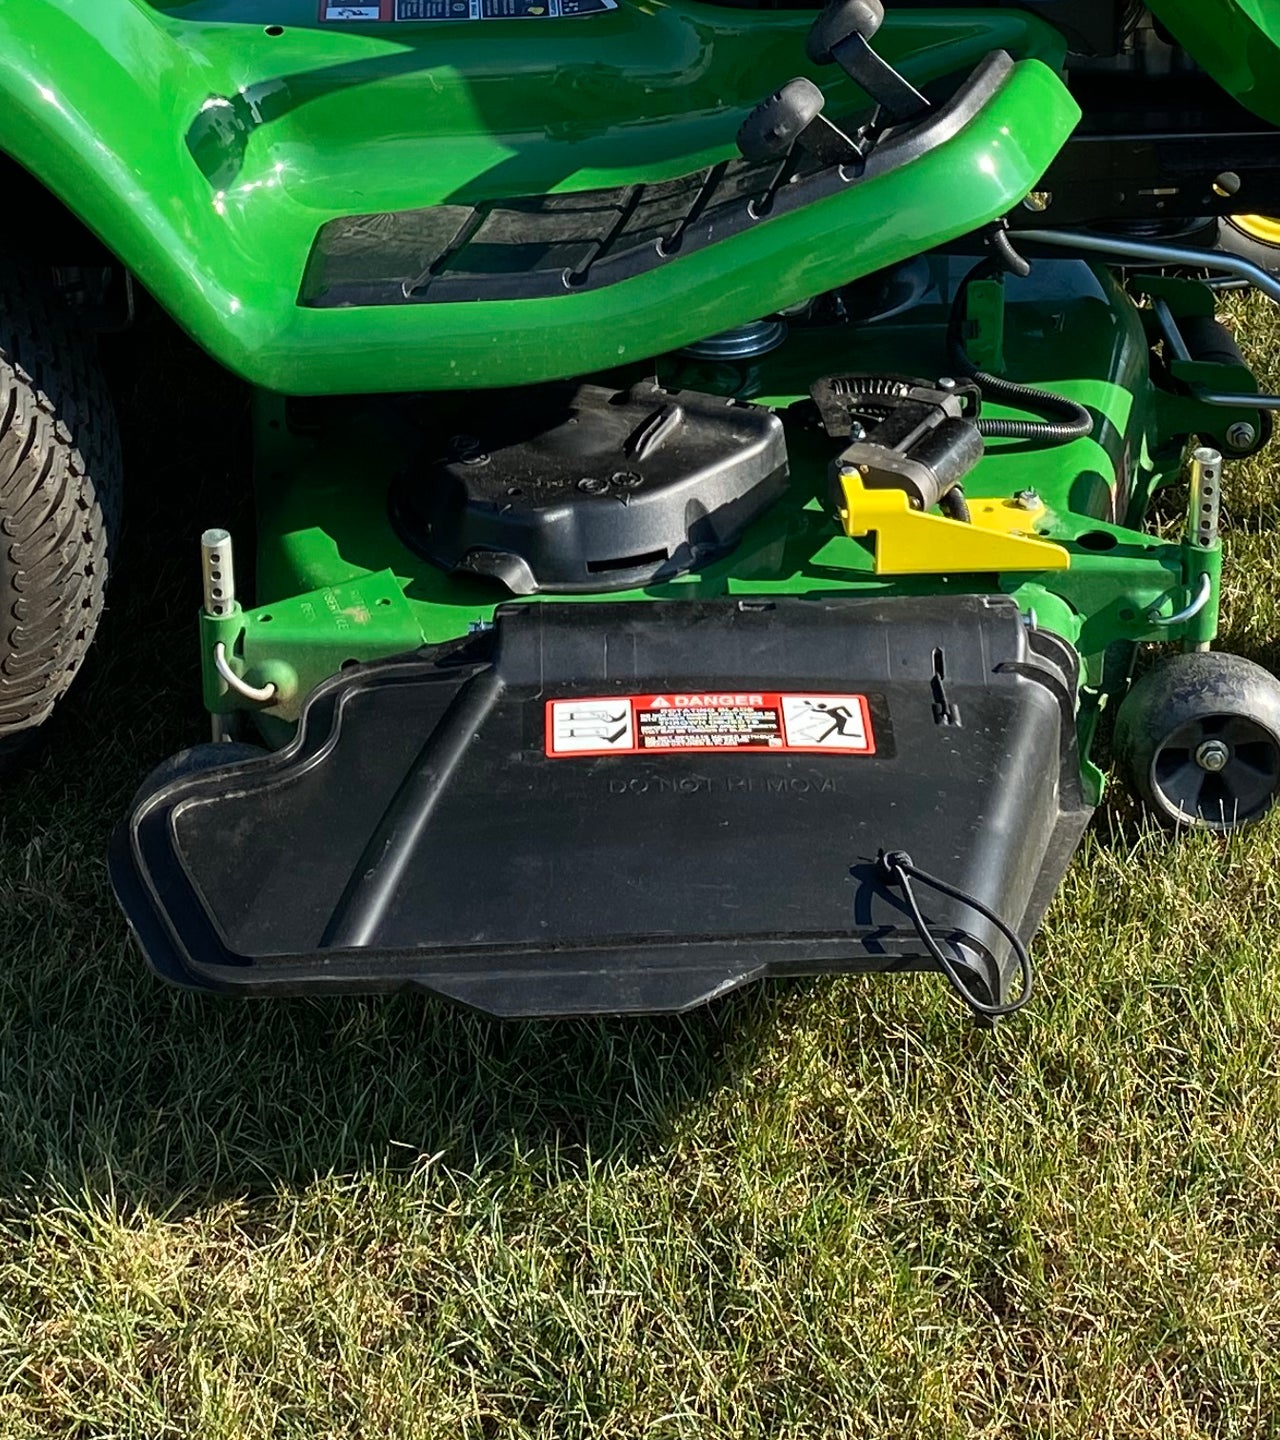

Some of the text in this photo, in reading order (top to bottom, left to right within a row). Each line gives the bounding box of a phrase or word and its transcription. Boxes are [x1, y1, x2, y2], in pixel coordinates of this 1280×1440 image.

[674, 694, 763, 707] DANGER
[609, 777, 649, 794] DO
[658, 776, 713, 793] NOT
